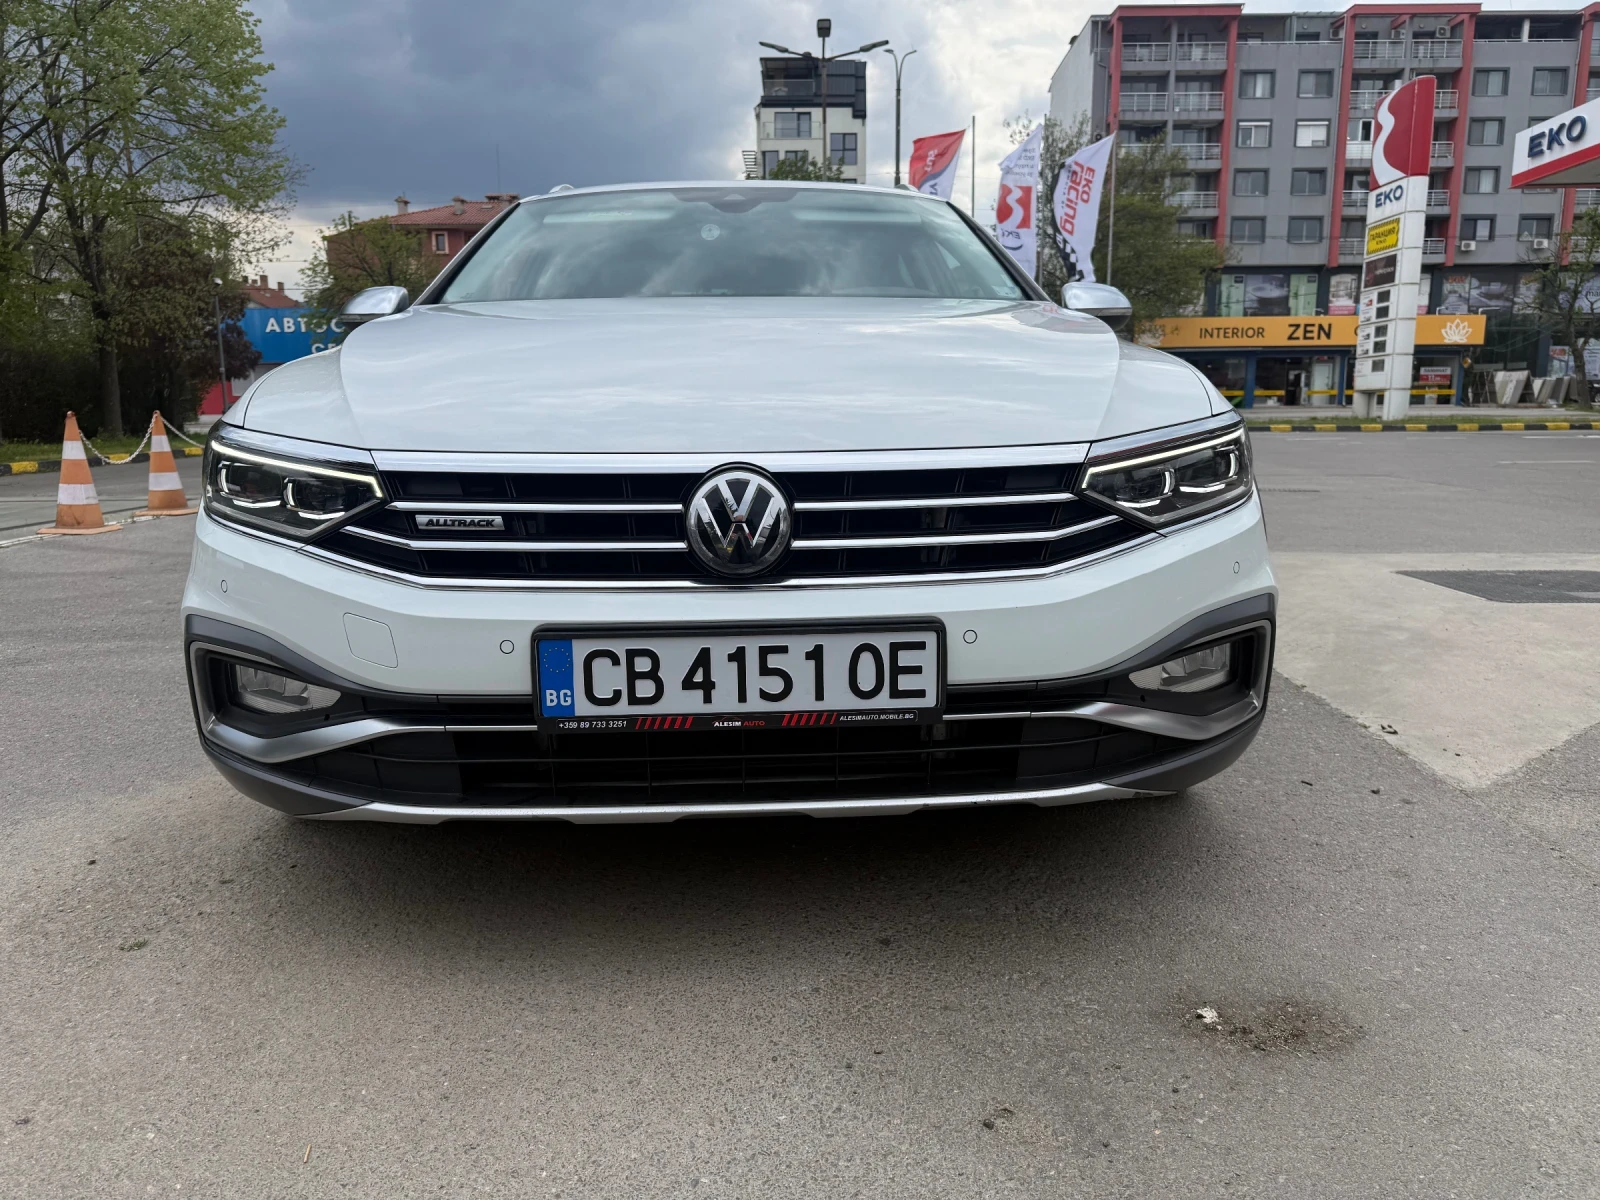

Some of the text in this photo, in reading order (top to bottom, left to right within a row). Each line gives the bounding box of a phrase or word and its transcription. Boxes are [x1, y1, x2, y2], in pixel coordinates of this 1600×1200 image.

[1528, 115, 1586, 158] EKO
[1060, 161, 1085, 236] racing
[1080, 166, 1096, 204] EKO
[1375, 185, 1403, 208] EKO
[1199, 323, 1332, 340] INTERIOR ZEN
[425, 518, 496, 527] ALLTRACK
[545, 689, 572, 707] BG
[582, 647, 665, 707] CB
[681, 643, 825, 704] 4151
[580, 721, 589, 729] 89
[608, 720, 627, 728] 3251
